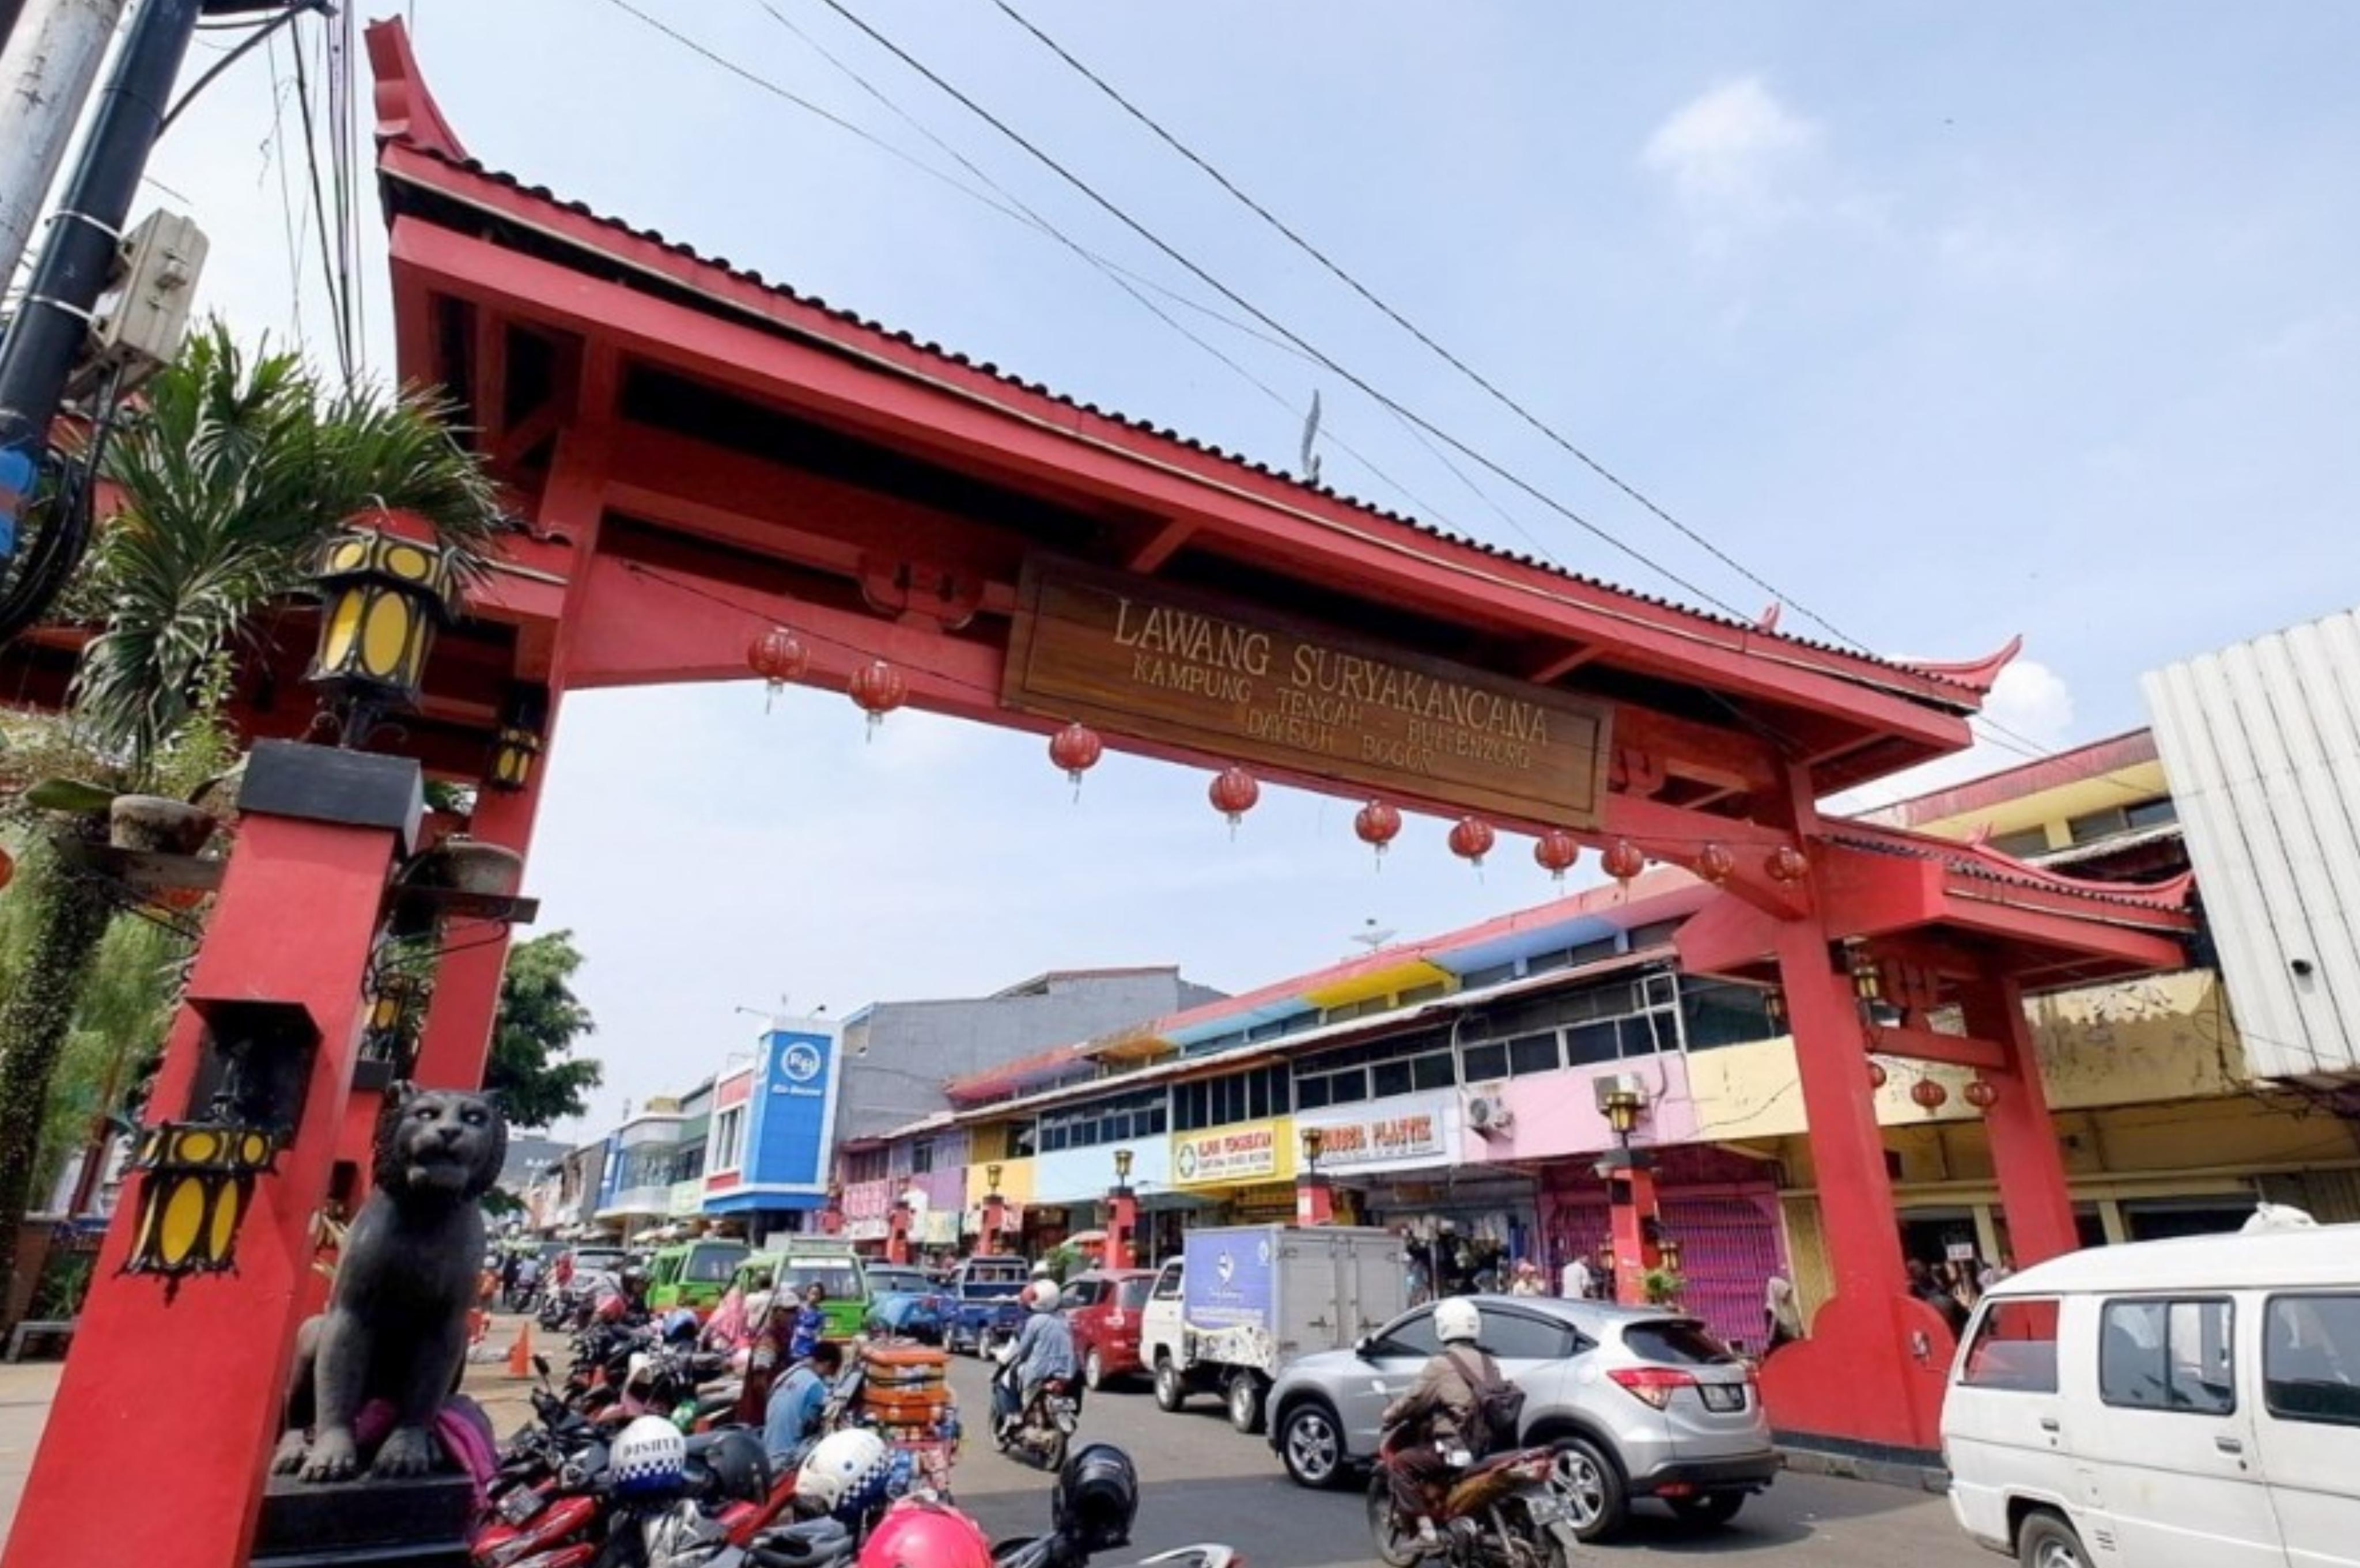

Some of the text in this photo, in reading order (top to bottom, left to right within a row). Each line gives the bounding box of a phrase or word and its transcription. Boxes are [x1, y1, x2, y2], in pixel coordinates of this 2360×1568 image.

[1113, 599, 1548, 745] LAWANG SURYAKANCANA
[1132, 652, 1253, 703] KAMPUNG
[1275, 687, 1363, 729] TENGAH
[1408, 718, 1530, 769] BUITENZORG
[1361, 735, 1435, 772] BOGOR
